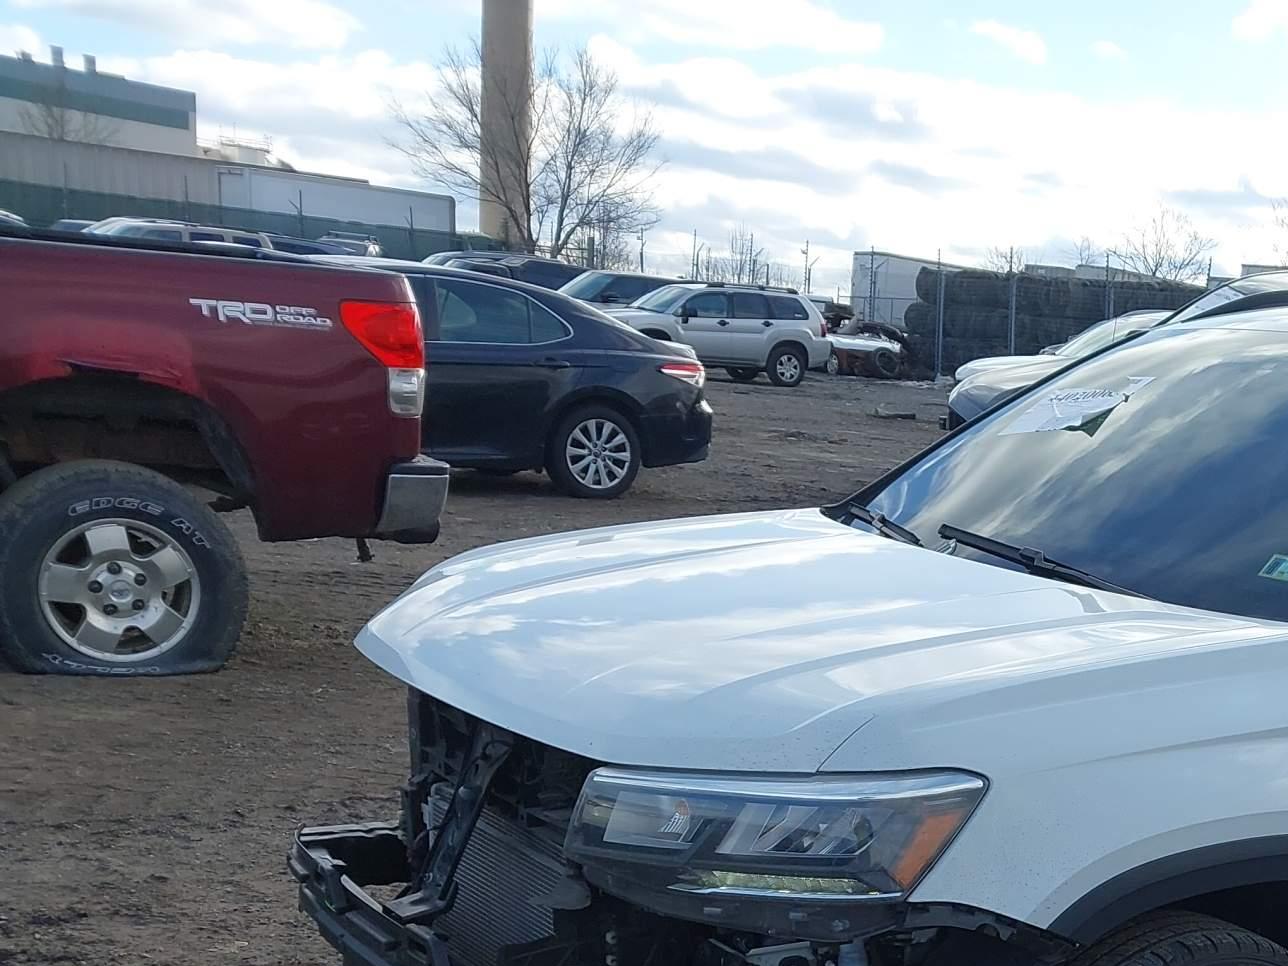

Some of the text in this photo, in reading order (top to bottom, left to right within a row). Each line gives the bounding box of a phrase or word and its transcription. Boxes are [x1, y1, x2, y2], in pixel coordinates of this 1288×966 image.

[189, 298, 275, 324] TRD
[275, 305, 317, 315] OFF
[276, 314, 333, 327] ROAD
[68, 497, 211, 549] EDGE AT
